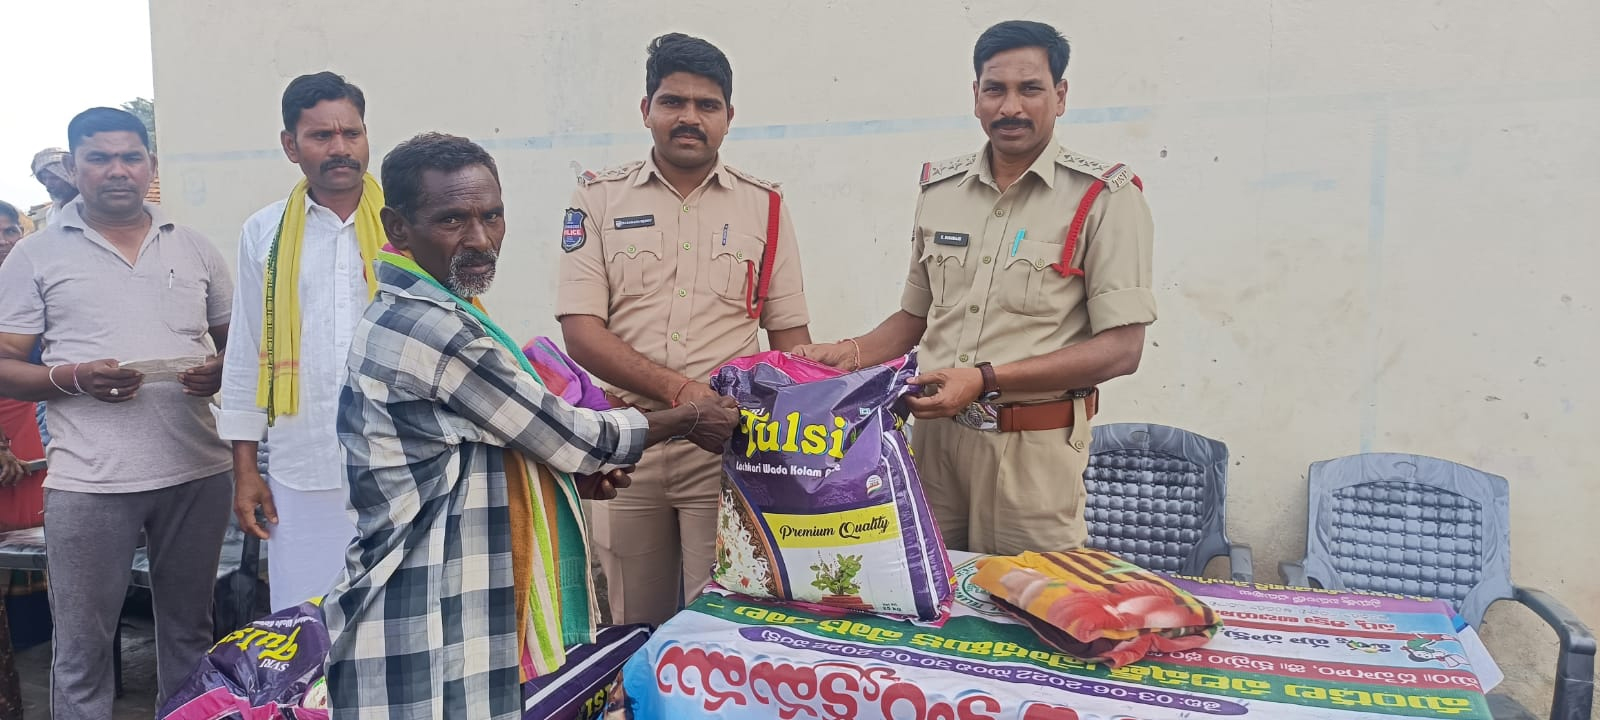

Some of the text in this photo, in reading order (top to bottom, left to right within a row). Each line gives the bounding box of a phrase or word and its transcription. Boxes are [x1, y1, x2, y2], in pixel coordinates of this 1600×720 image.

[740, 411, 846, 459] Tulsi
[763, 463, 788, 475] Wada
[790, 466, 822, 477] Kolam
[780, 516, 890, 541] Premium Quality
[761, 630, 810, 648] వరకు
[259, 658, 289, 672] SVRI
[815, 643, 952, 668] 30-06-2022
[956, 662, 1011, 678] నుంచి
[1107, 666, 1271, 696] పరిషత్
[1016, 670, 1173, 704] 03-06-2022
[1284, 684, 1472, 714] మండల
